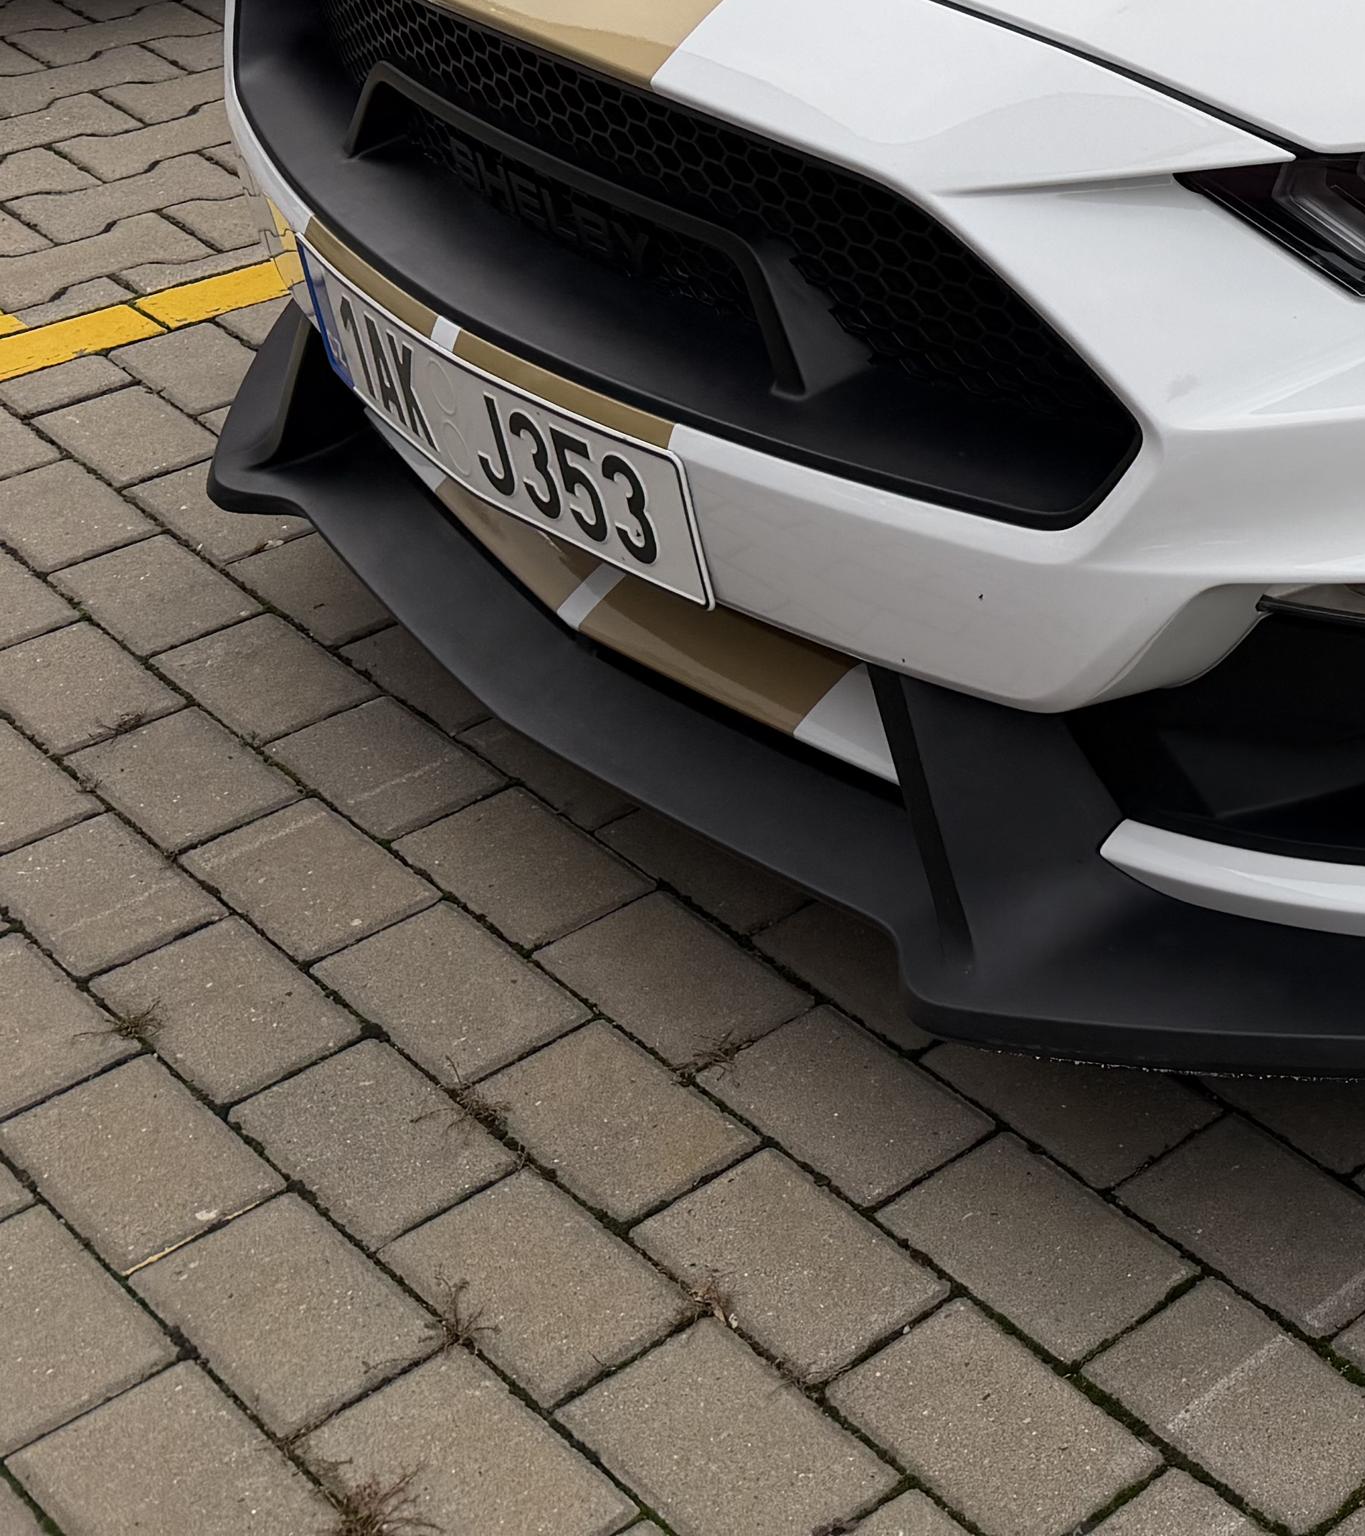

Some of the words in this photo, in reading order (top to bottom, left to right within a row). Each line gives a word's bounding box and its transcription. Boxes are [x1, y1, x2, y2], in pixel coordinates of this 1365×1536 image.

[449, 135, 650, 275] SHELBY
[340, 295, 440, 453] 1AK
[477, 393, 658, 565] J353
